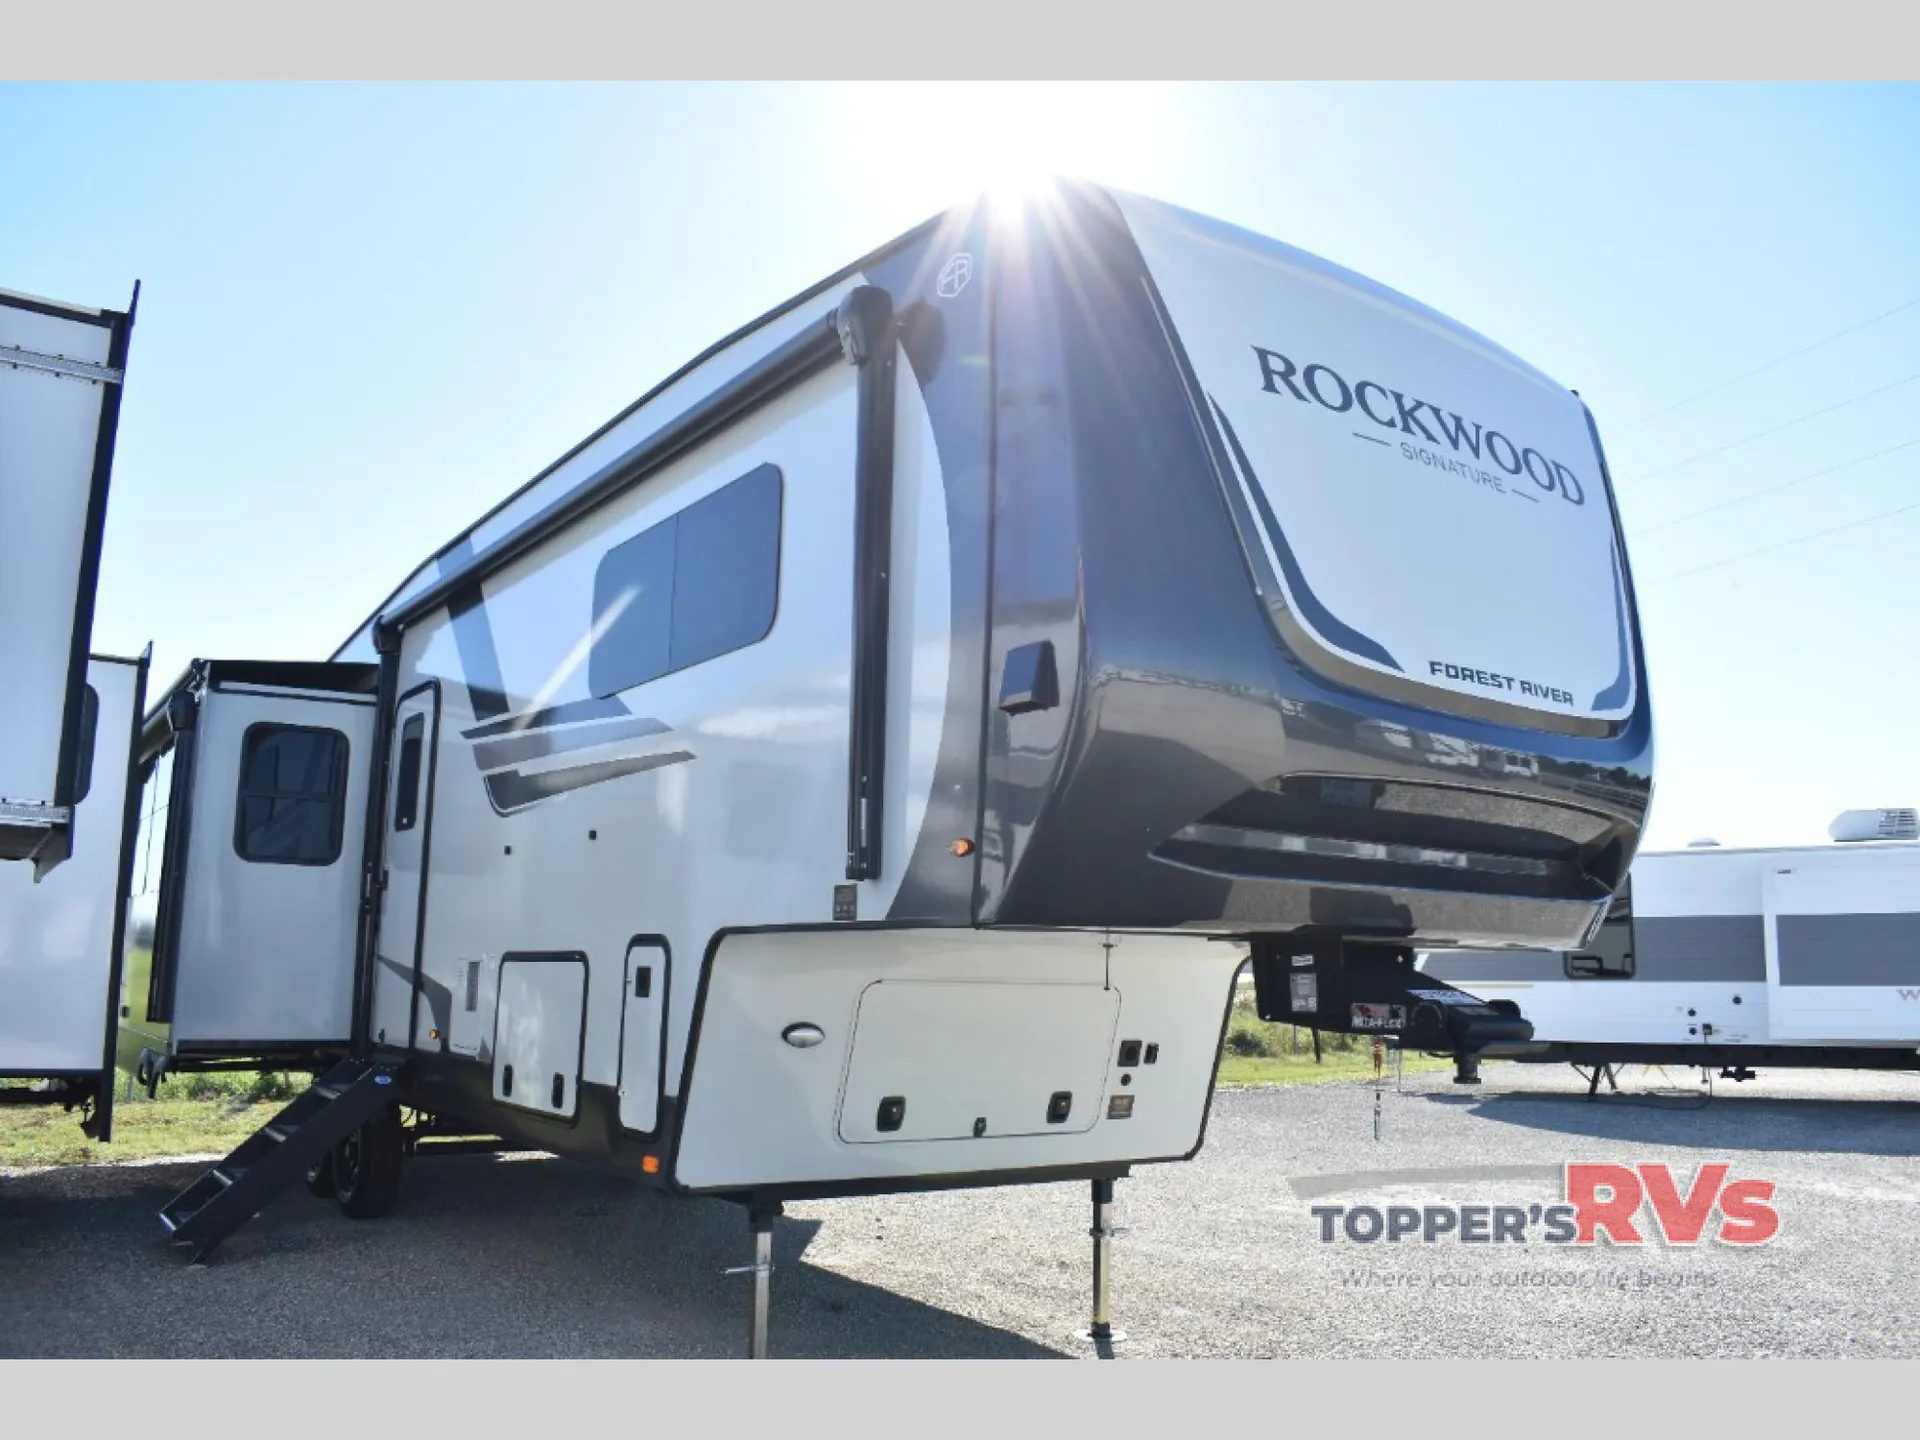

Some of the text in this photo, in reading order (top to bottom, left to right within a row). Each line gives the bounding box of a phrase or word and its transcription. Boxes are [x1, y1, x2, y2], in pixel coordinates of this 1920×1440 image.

[1250, 344, 1585, 506] ROCKWOOD
[1400, 441, 1506, 493] SIGNATURE
[1428, 660, 1574, 706] FOREST RIVER
